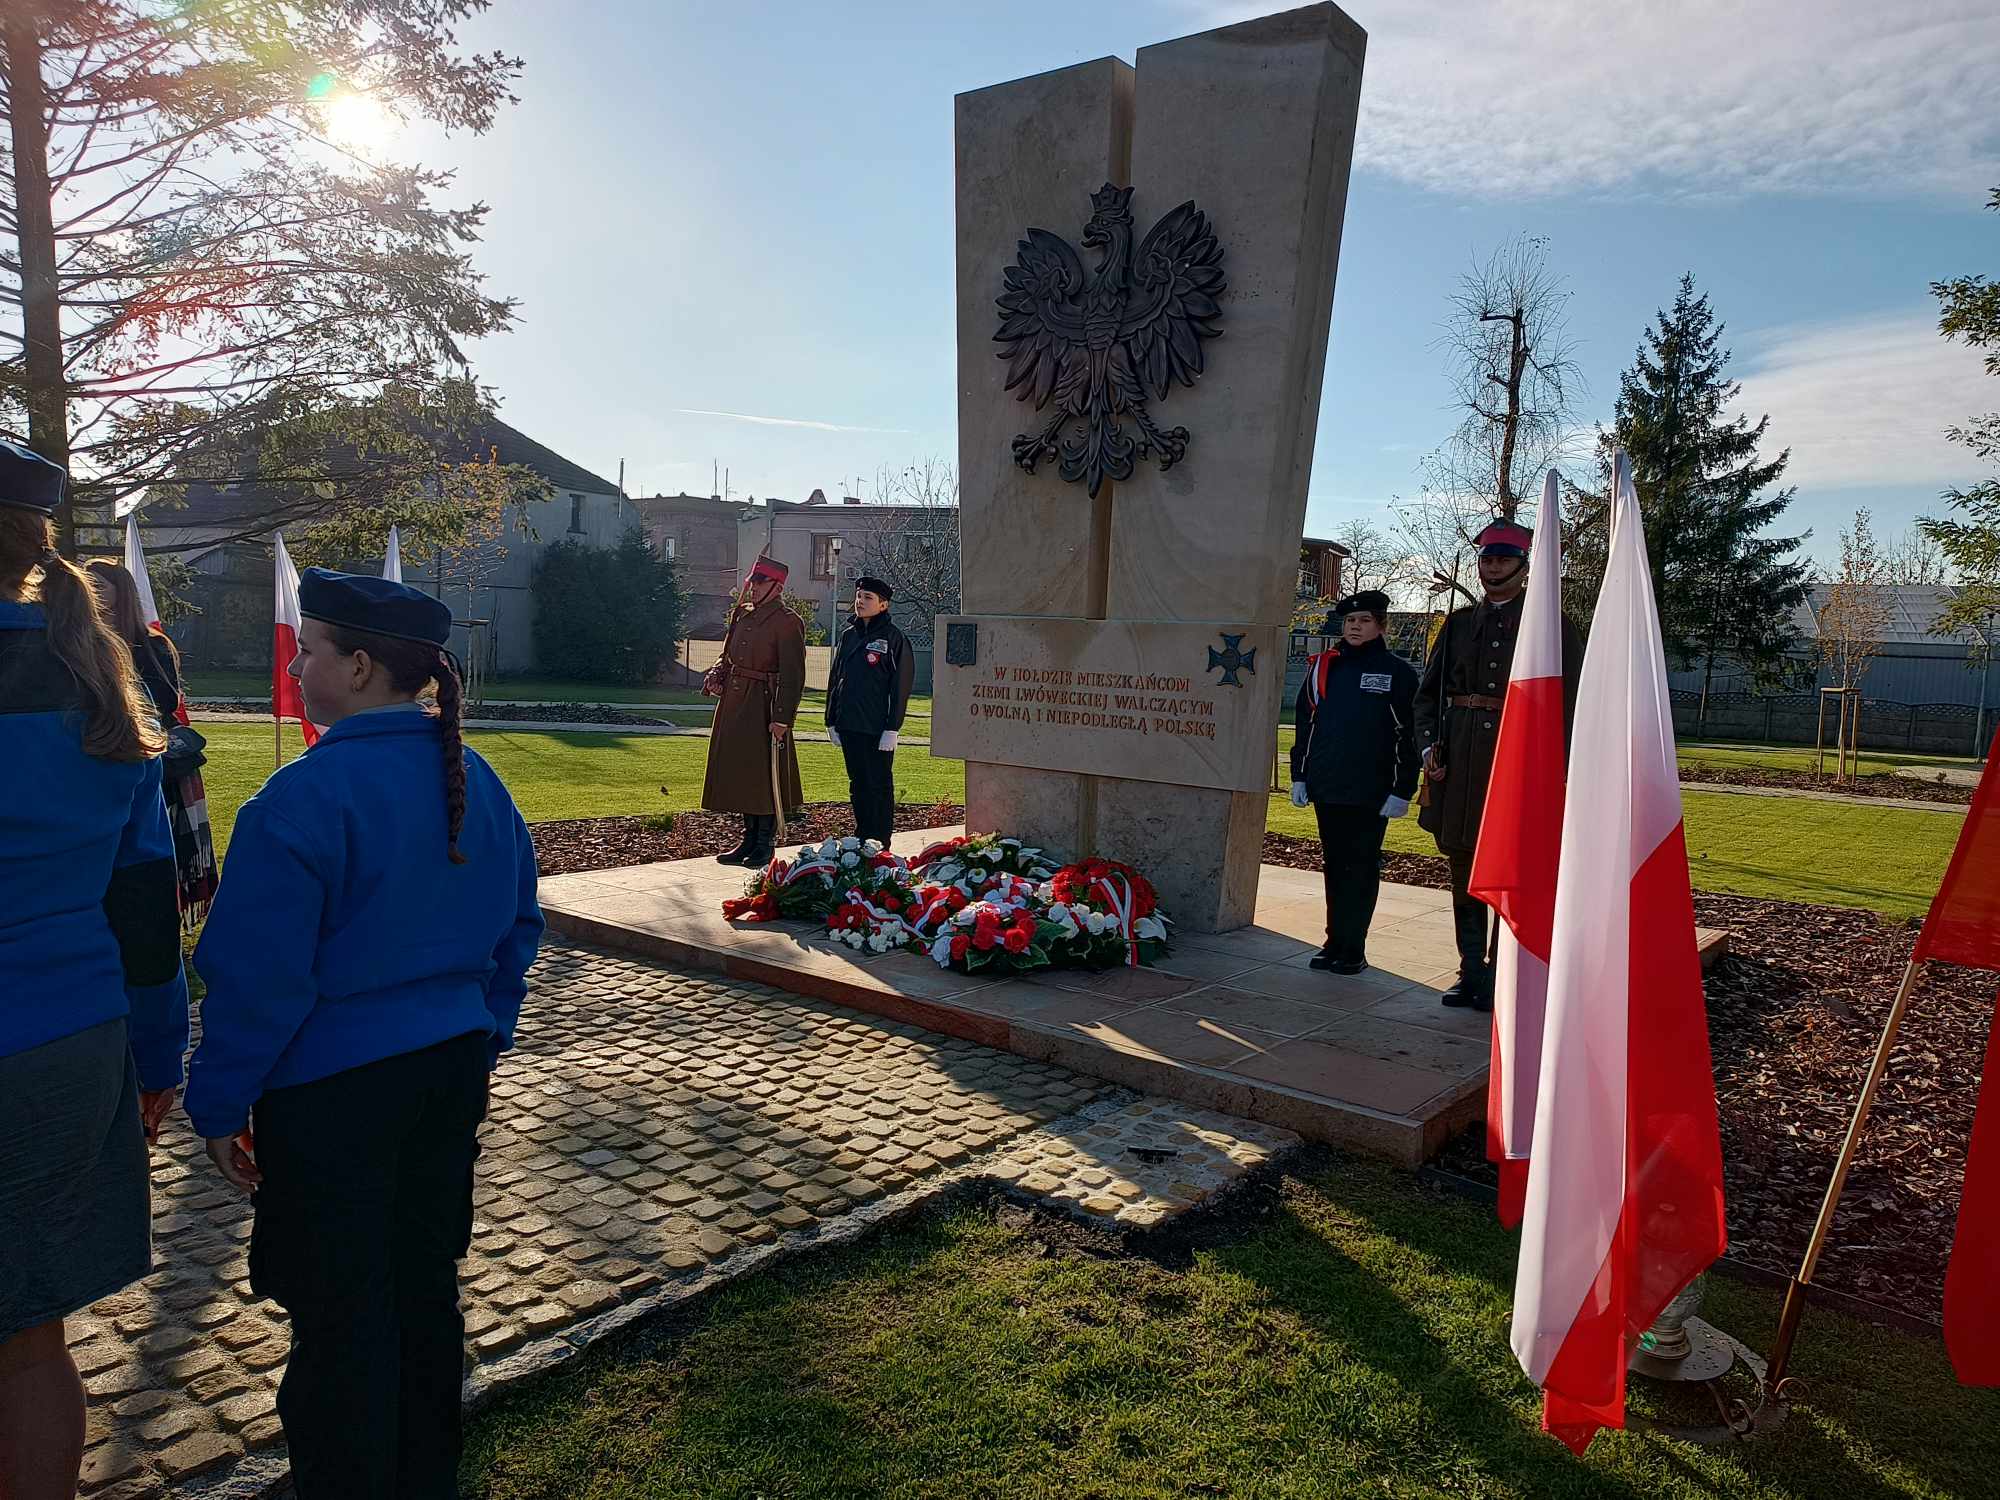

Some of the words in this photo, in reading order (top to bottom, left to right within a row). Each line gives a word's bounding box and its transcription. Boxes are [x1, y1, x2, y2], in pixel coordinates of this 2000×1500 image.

[993, 666, 1008, 681] W
[1013, 668, 1073, 686] HOŁDZIE
[1077, 671, 1190, 693] MIESZKAŃCOM
[972, 684, 1010, 700] ZIEMI
[1016, 685, 1108, 711] LWÓWECKIEJ
[1114, 694, 1214, 717] WALCZĄCYM
[970, 703, 979, 716] O
[983, 704, 1031, 725] WOLNĄ
[1036, 708, 1041, 722] I
[1046, 708, 1148, 735] NIEPODLEGŁĄ
[1152, 718, 1216, 741] POLSKĘ
